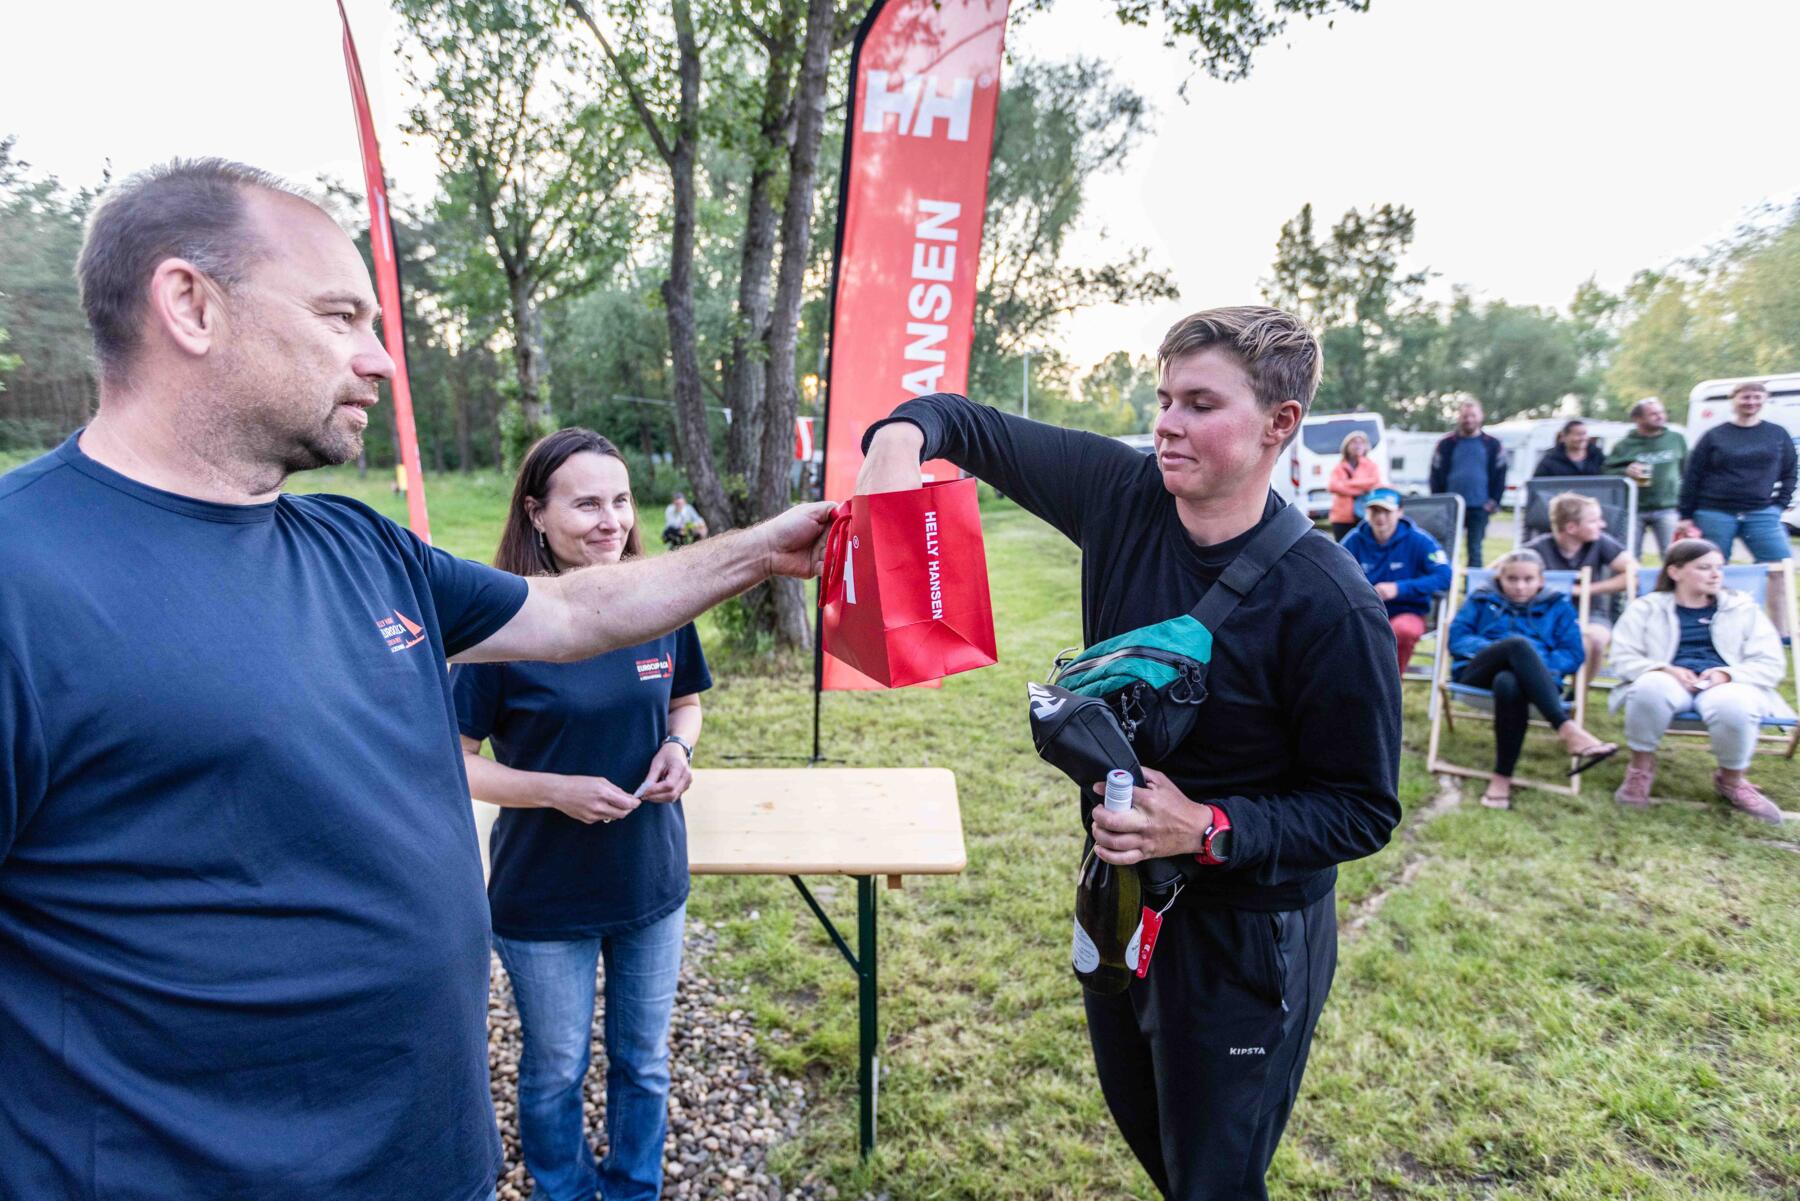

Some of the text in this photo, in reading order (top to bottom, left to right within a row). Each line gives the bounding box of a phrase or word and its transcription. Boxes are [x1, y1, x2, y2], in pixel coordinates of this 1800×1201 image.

[901, 199, 961, 396] ANSEN
[925, 511, 943, 620] HELLY HANSEN
[1229, 1047, 1266, 1055] KIPSTA
